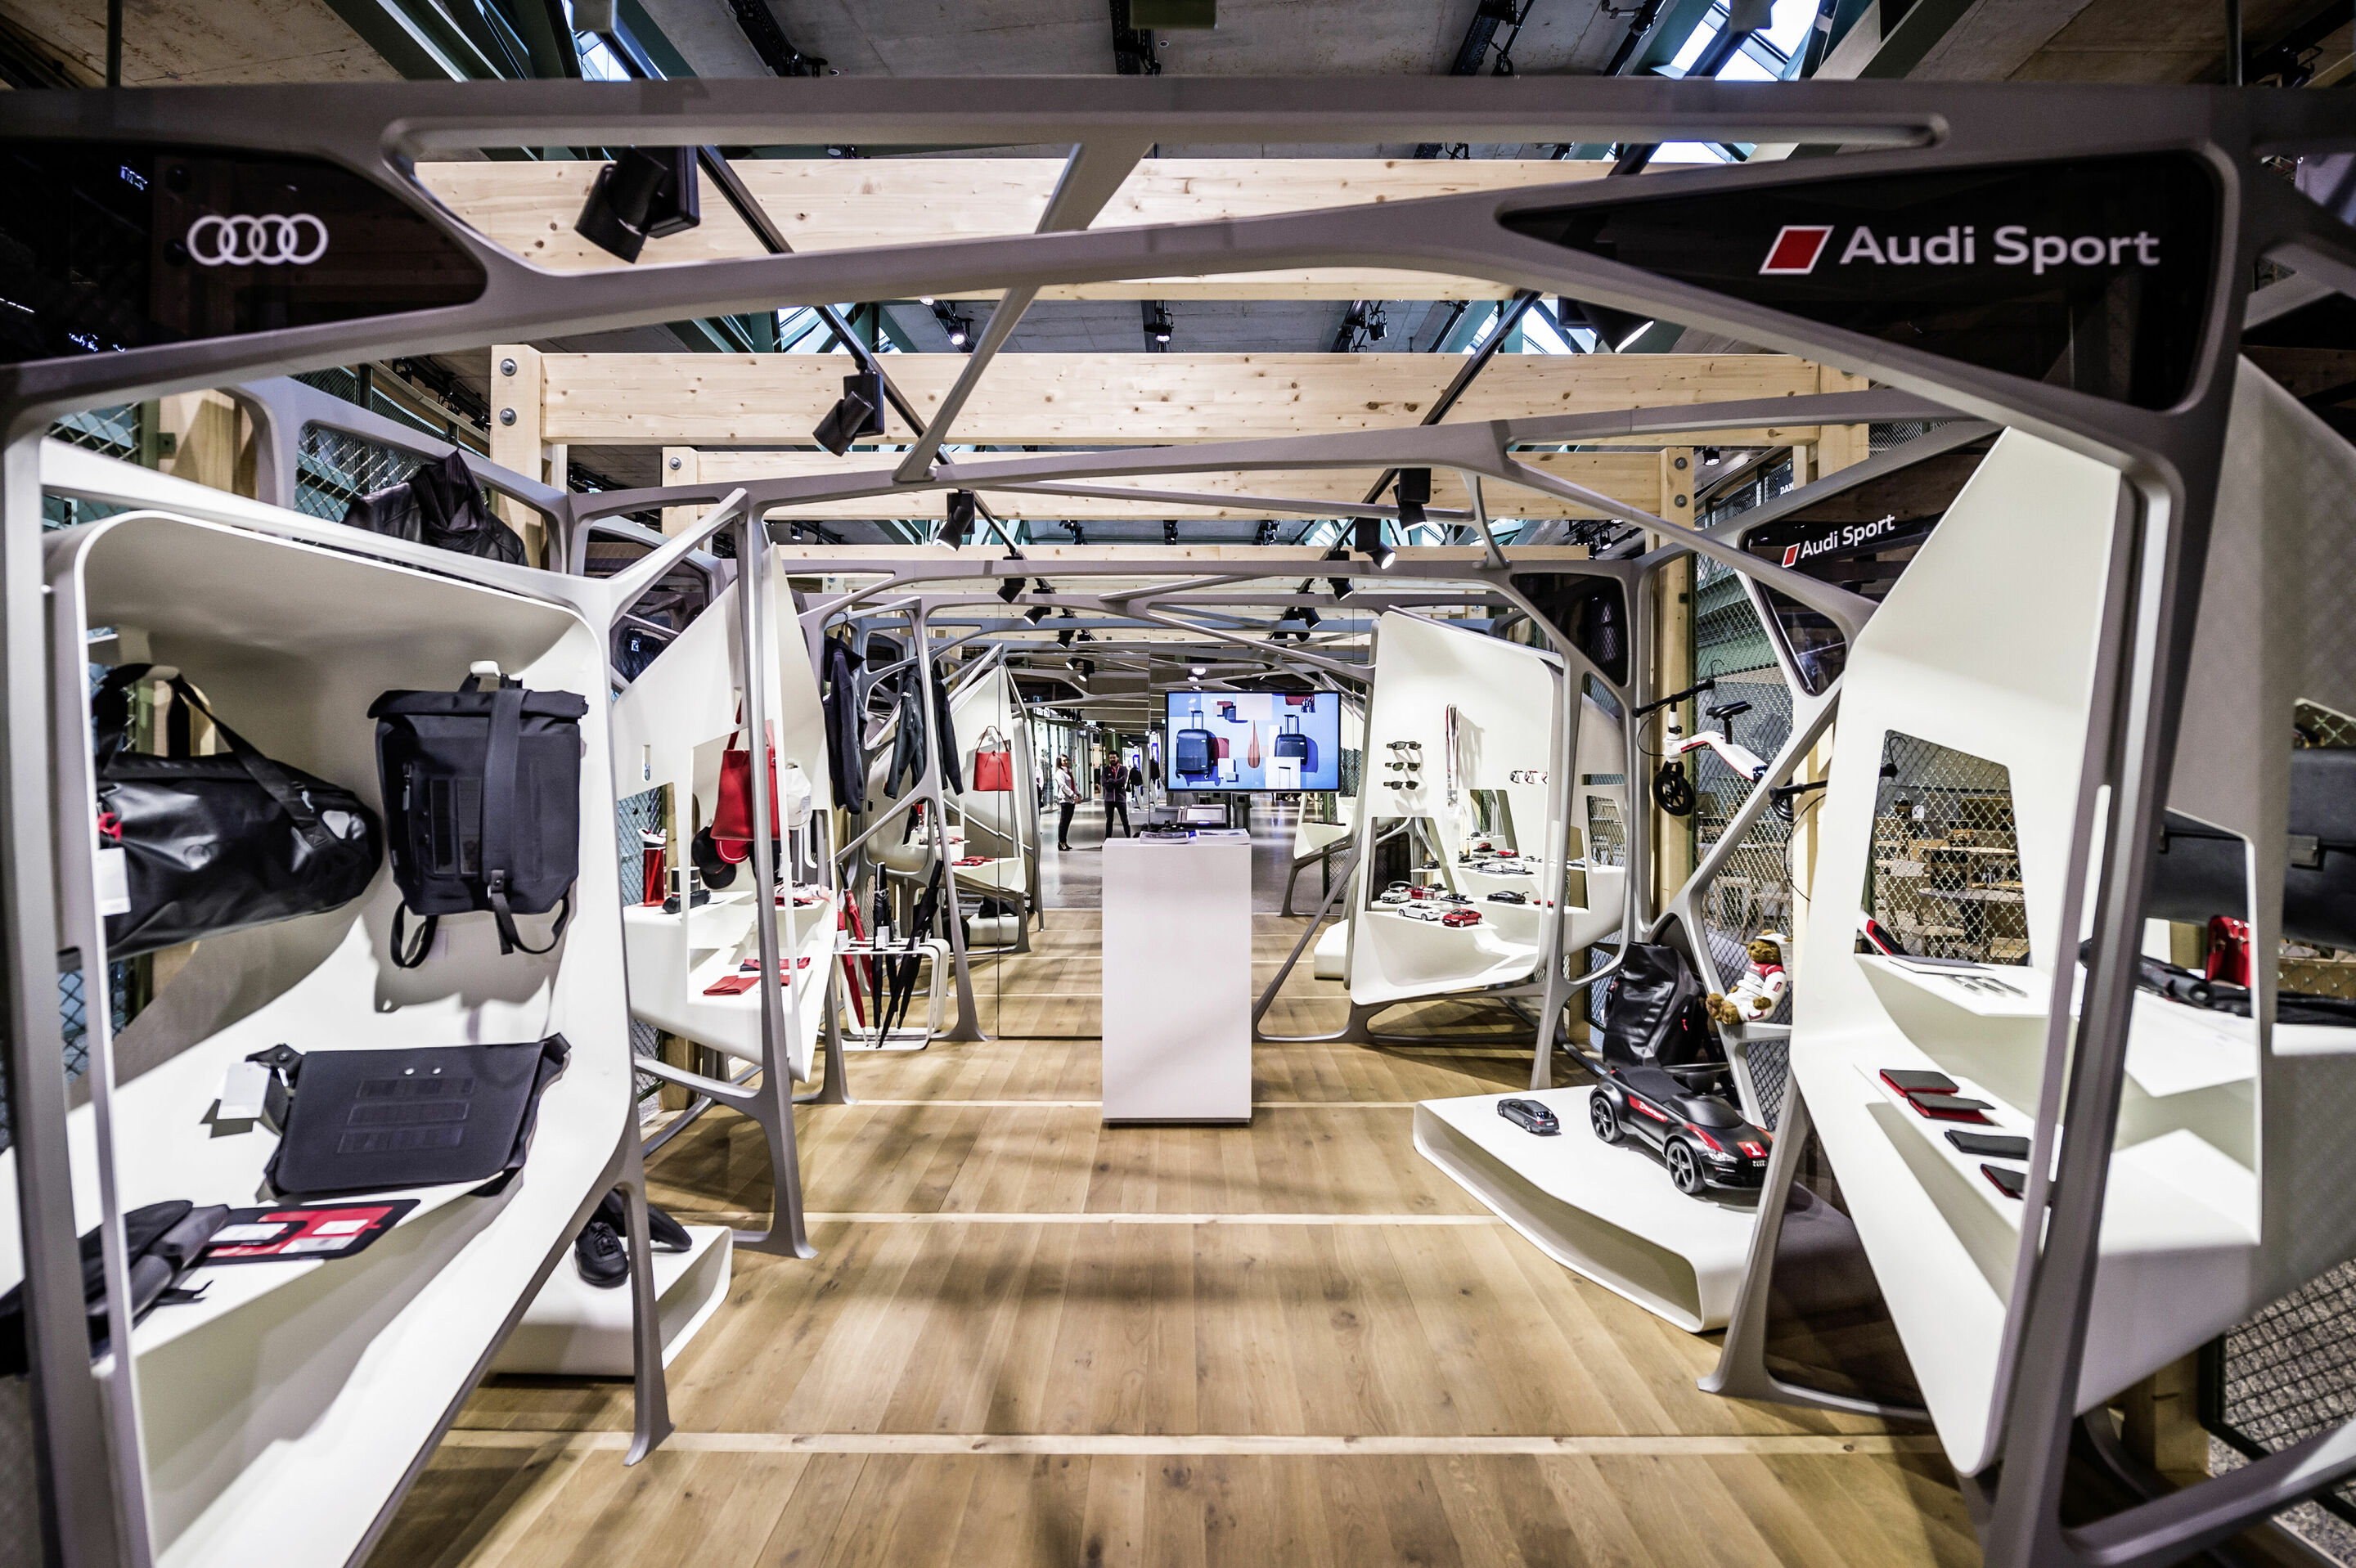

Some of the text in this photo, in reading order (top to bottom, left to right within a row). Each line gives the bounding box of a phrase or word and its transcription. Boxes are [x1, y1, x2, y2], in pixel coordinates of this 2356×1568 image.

[1839, 225, 2160, 275] Audi Sport
[1801, 514, 1895, 559] Audi Sport
[1746, 1143, 1761, 1156] 1
